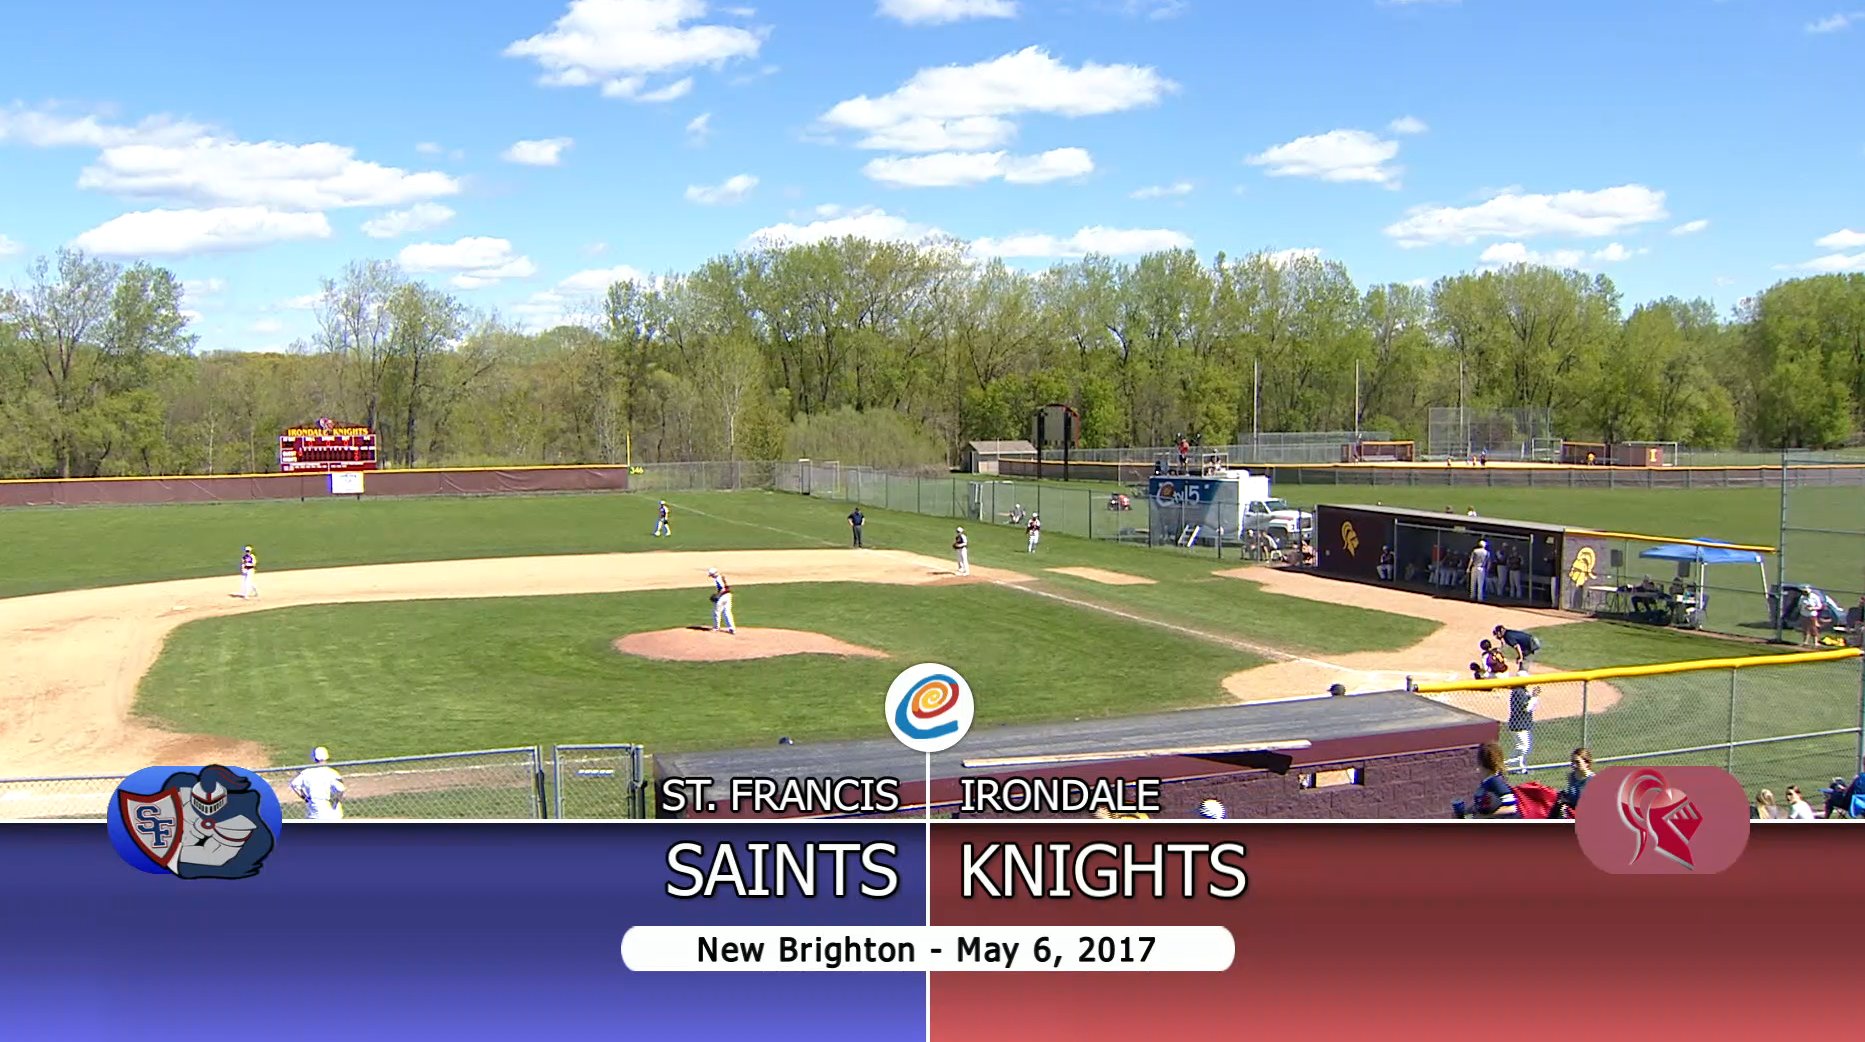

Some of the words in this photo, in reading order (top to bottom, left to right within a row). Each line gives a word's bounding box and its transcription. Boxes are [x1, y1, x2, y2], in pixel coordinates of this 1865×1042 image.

[287, 428, 329, 437] IRONDALE
[332, 427, 369, 436] KNIGHTS
[629, 466, 644, 475] 346
